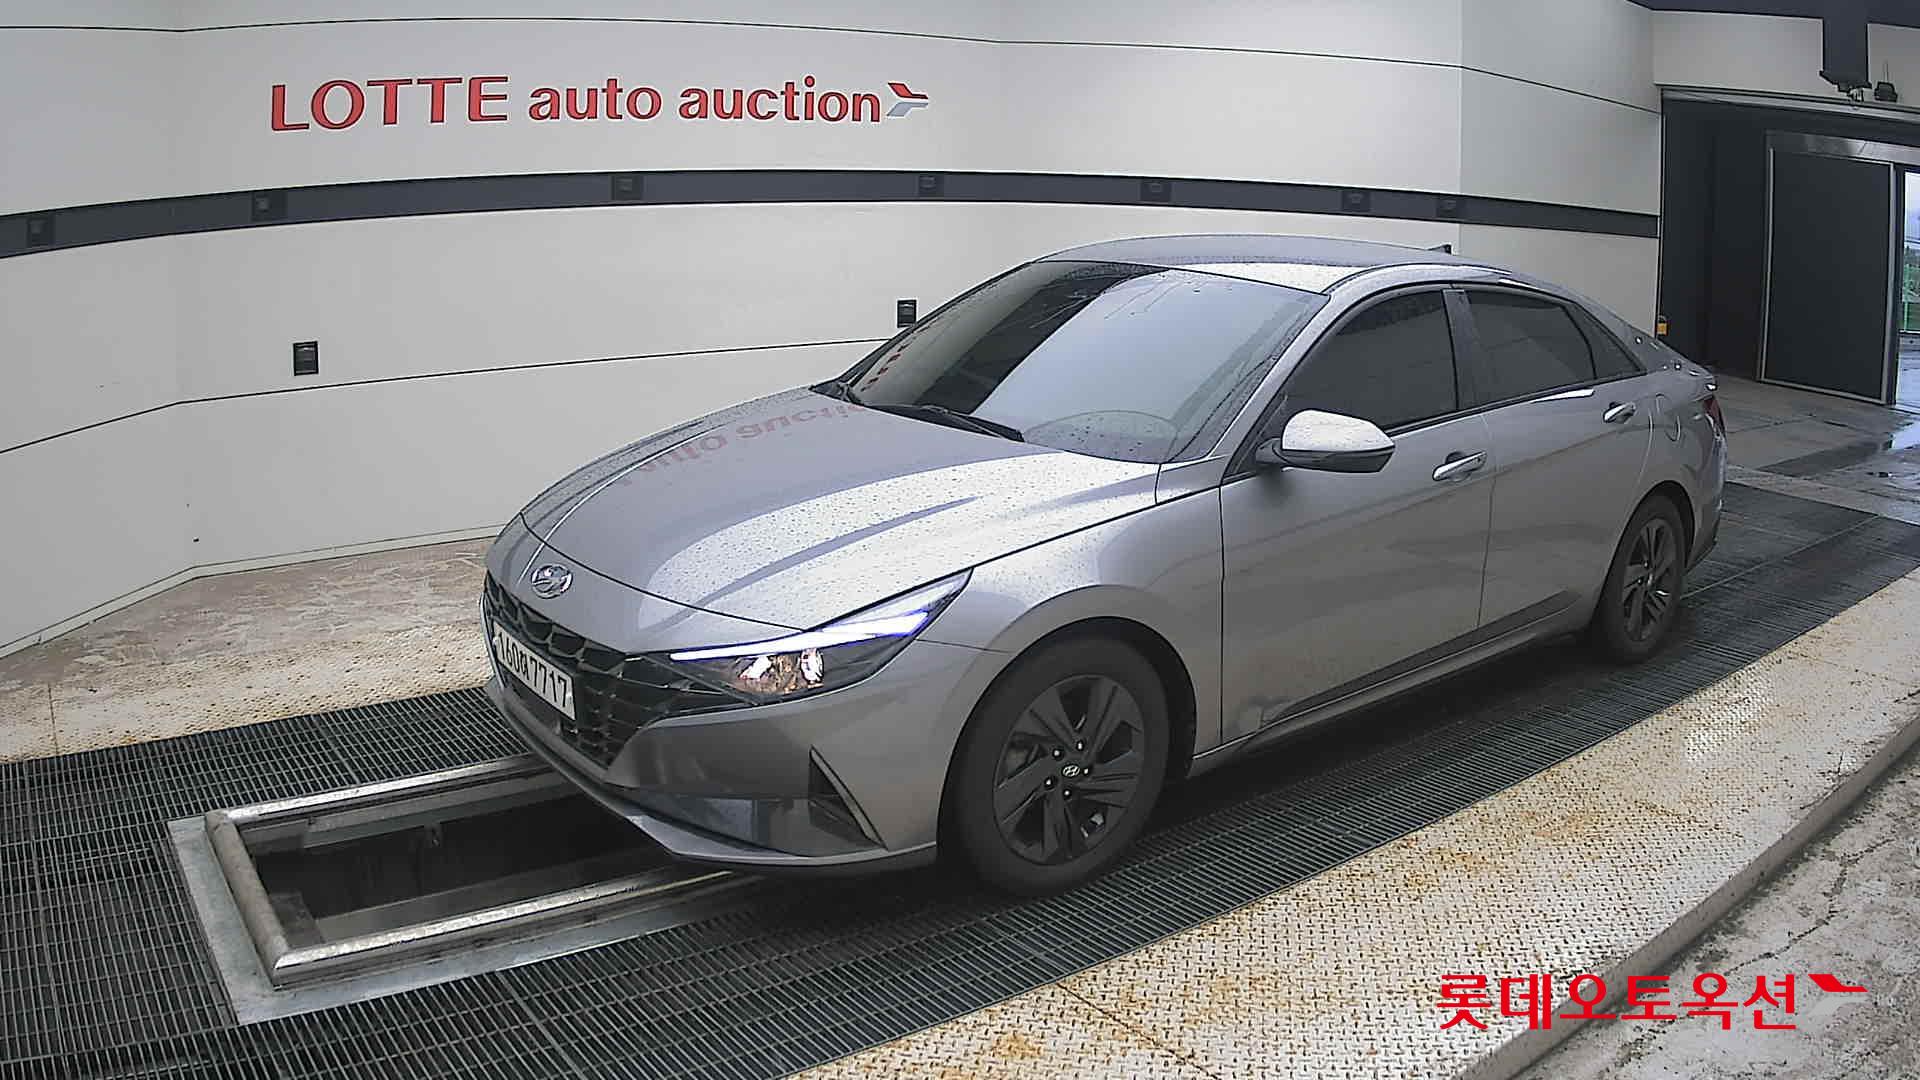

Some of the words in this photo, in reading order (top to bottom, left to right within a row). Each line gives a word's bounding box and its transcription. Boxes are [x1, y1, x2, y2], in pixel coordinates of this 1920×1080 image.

[270, 76, 509, 132] LOTTE
[528, 78, 662, 121] auto
[678, 75, 881, 122] auction
